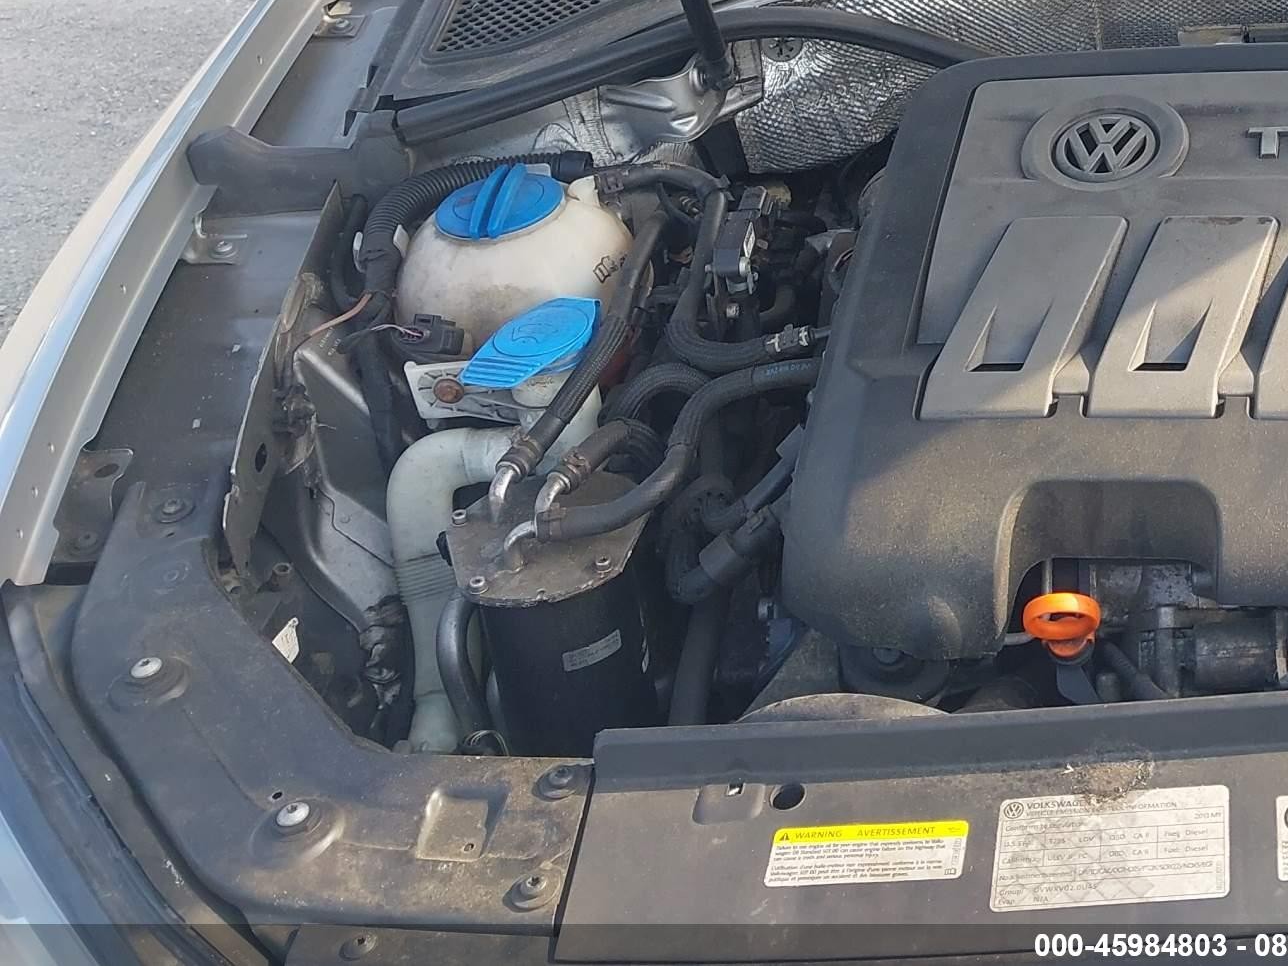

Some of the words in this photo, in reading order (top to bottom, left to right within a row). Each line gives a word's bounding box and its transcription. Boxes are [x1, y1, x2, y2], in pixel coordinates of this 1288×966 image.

[795, 830, 843, 840] WARNING
[857, 826, 936, 837] AVERTISSEMENT
[1185, 828, 1208, 837] Diesel
[1185, 843, 1208, 852] Diesel
